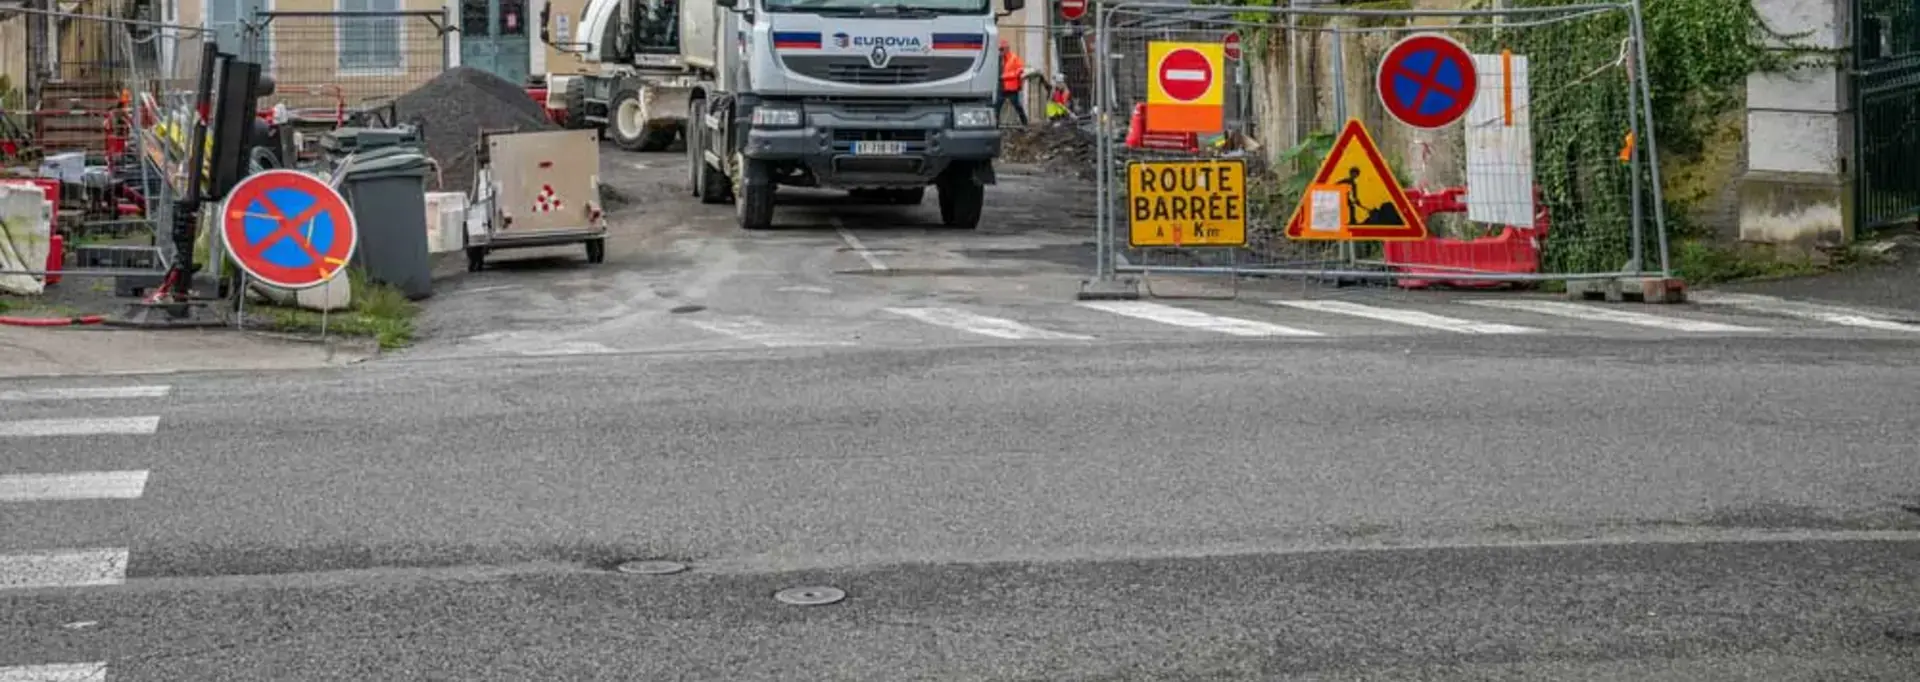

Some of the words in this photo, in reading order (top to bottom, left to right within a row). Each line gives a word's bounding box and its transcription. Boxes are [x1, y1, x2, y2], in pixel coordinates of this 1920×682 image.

[854, 36, 920, 46] EUROVIA
[1140, 166, 1233, 192] ROUTE
[1134, 192, 1240, 221] BARRÉE
